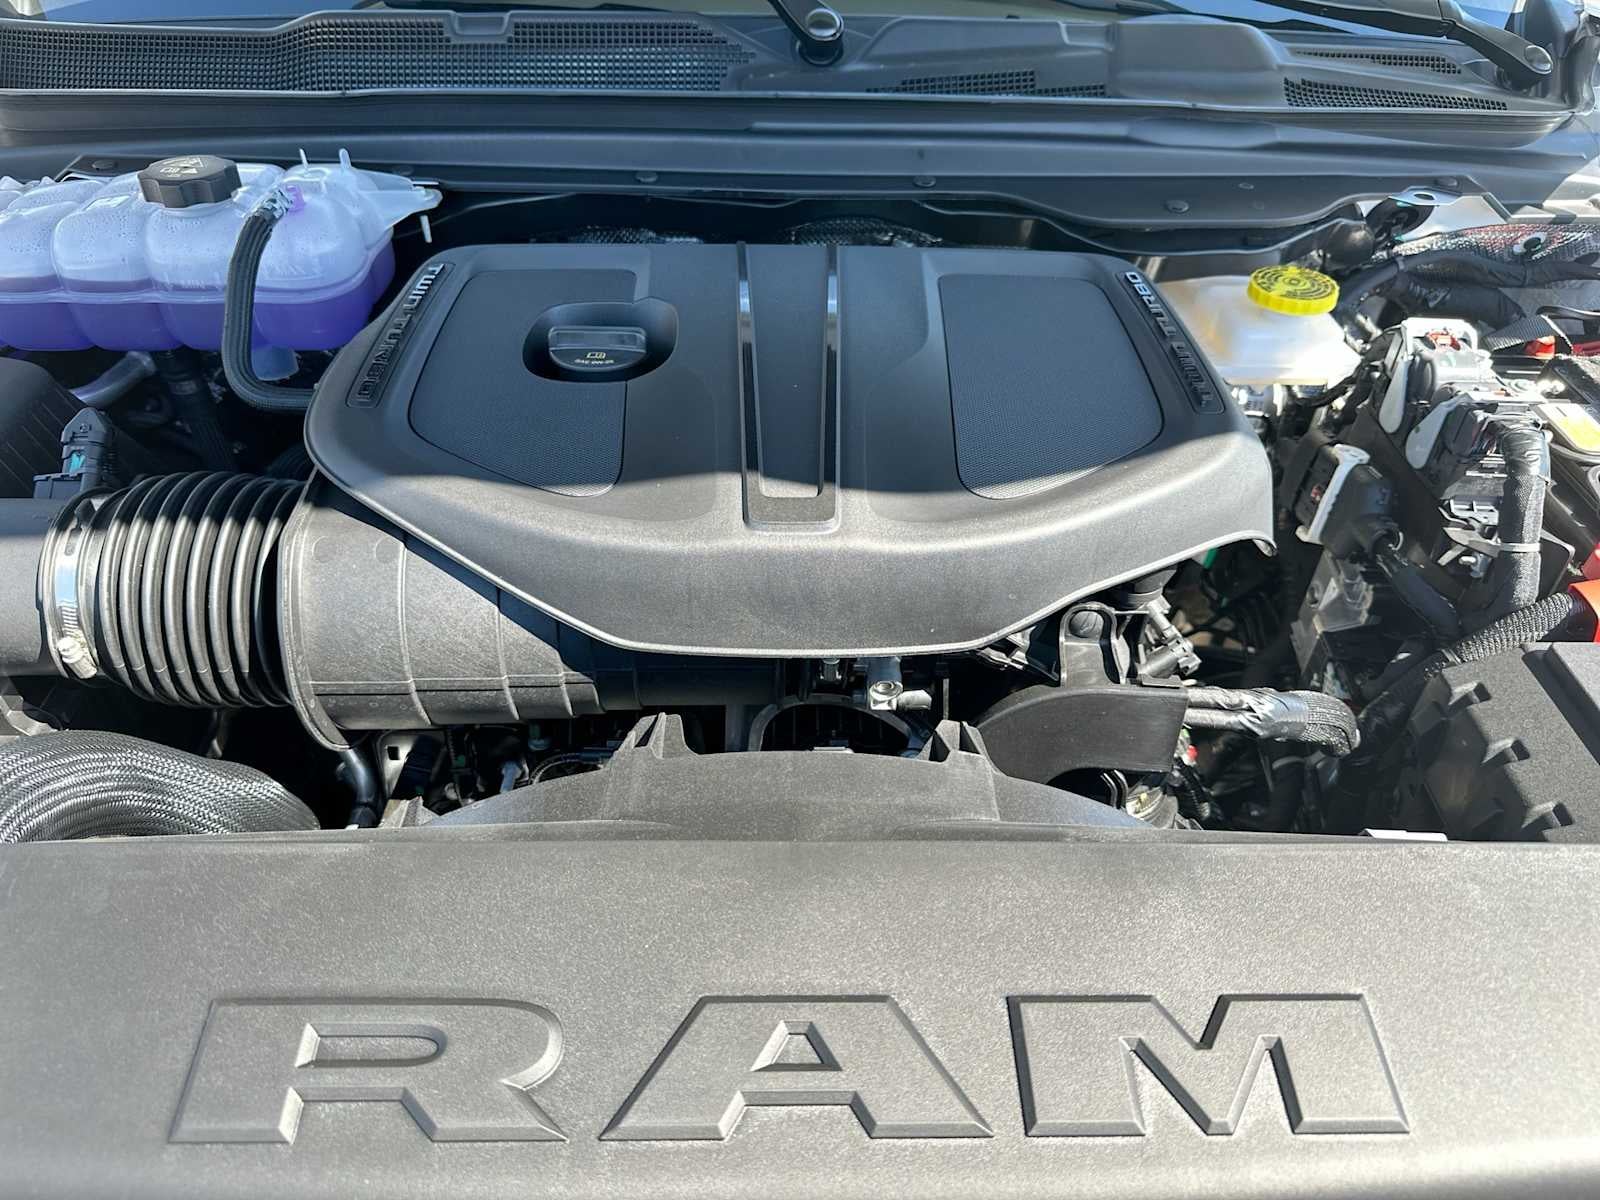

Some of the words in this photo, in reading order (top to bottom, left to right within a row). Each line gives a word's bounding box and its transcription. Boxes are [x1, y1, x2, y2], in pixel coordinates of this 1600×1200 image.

[402, 263, 445, 315] TWIN
[1125, 271, 1177, 336] TURBO
[356, 313, 413, 402] TURBO
[168, 993, 1410, 1144] RAM
